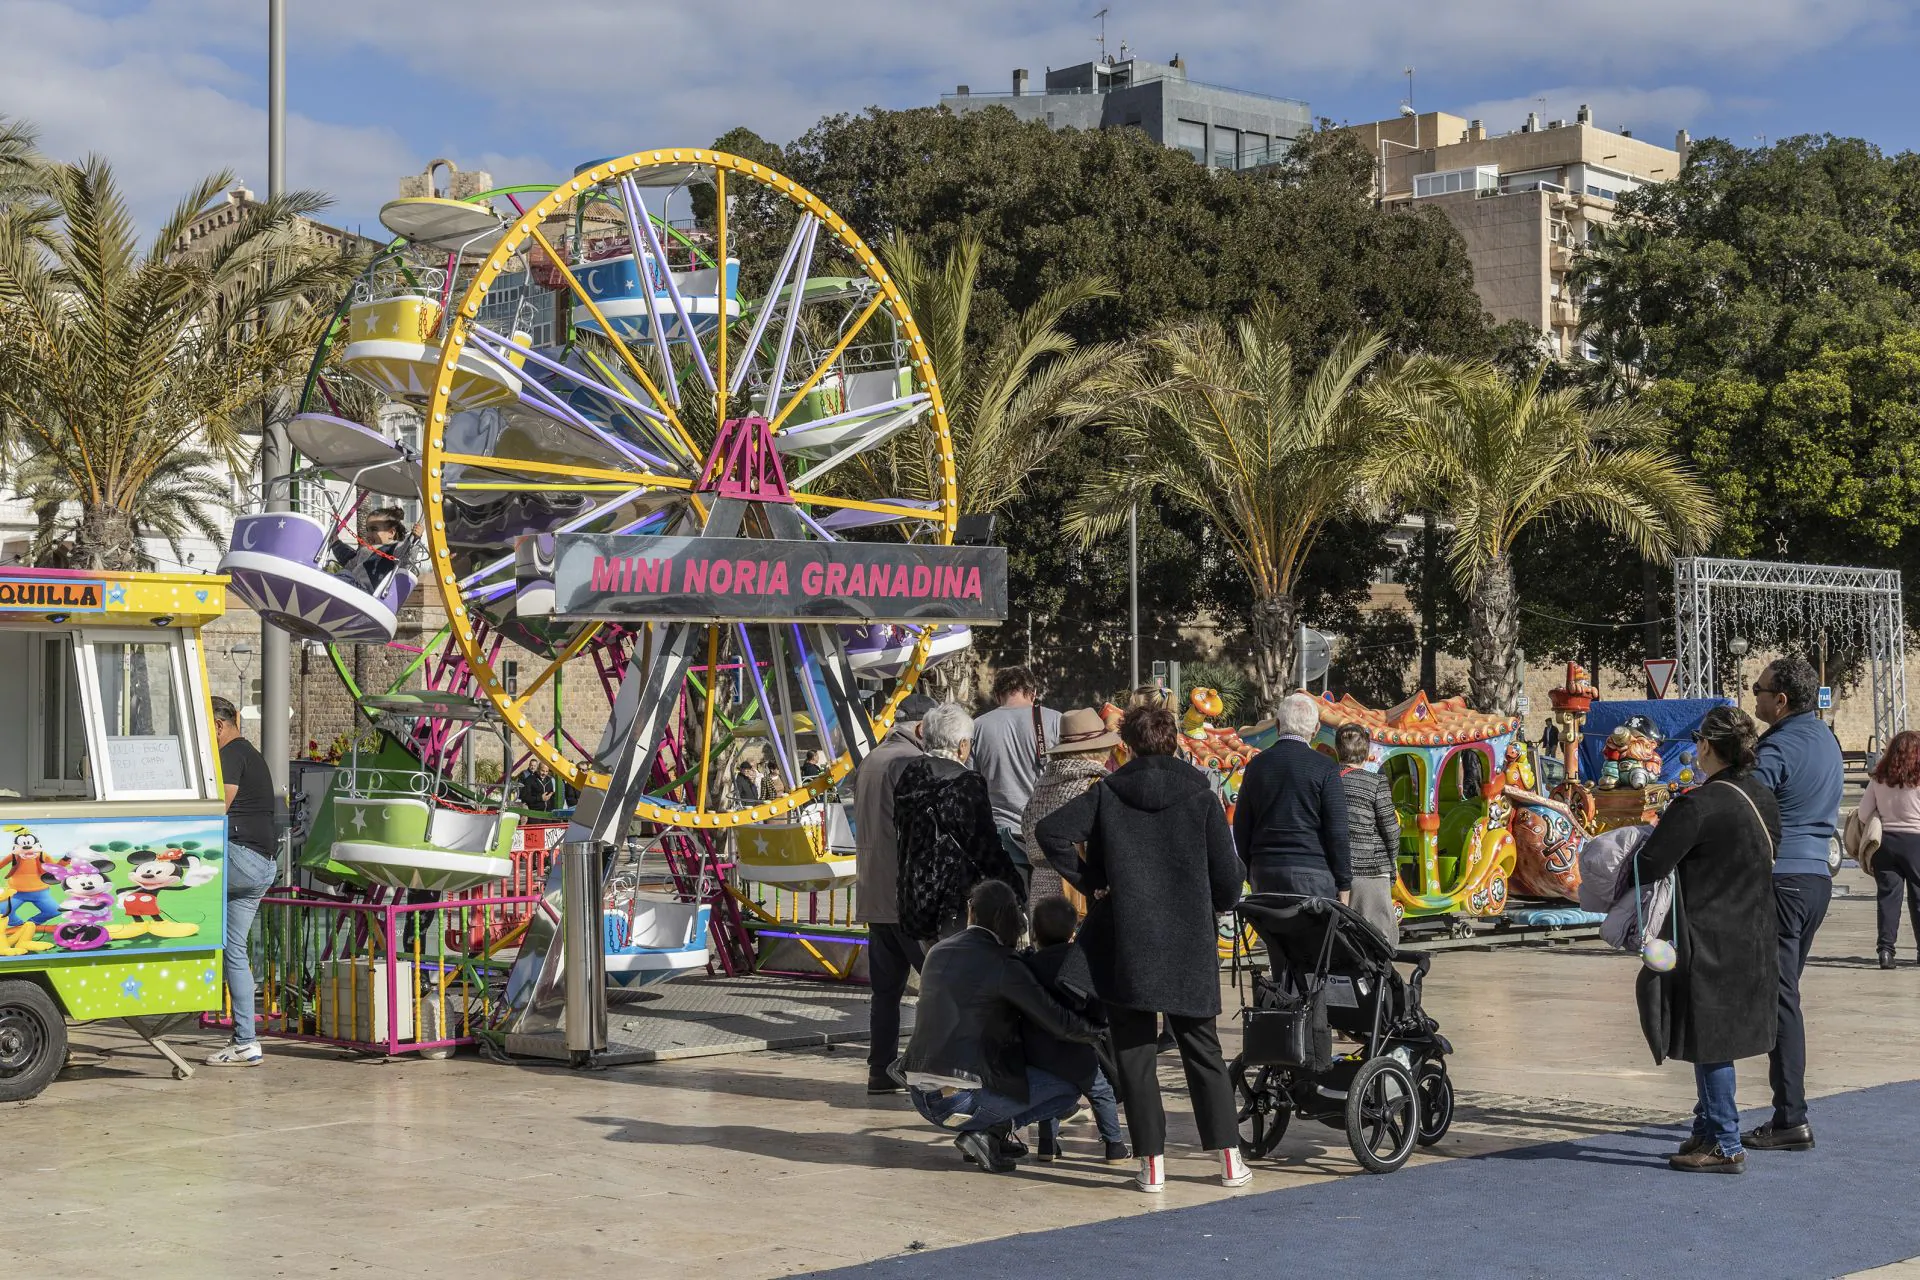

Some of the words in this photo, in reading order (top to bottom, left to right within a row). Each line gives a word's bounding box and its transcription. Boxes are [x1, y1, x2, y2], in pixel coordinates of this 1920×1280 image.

[590, 556, 673, 593] MINI
[682, 559, 790, 595] NORIA
[801, 562, 982, 599] GRANADINA
[0, 584, 97, 606] QUILLA
